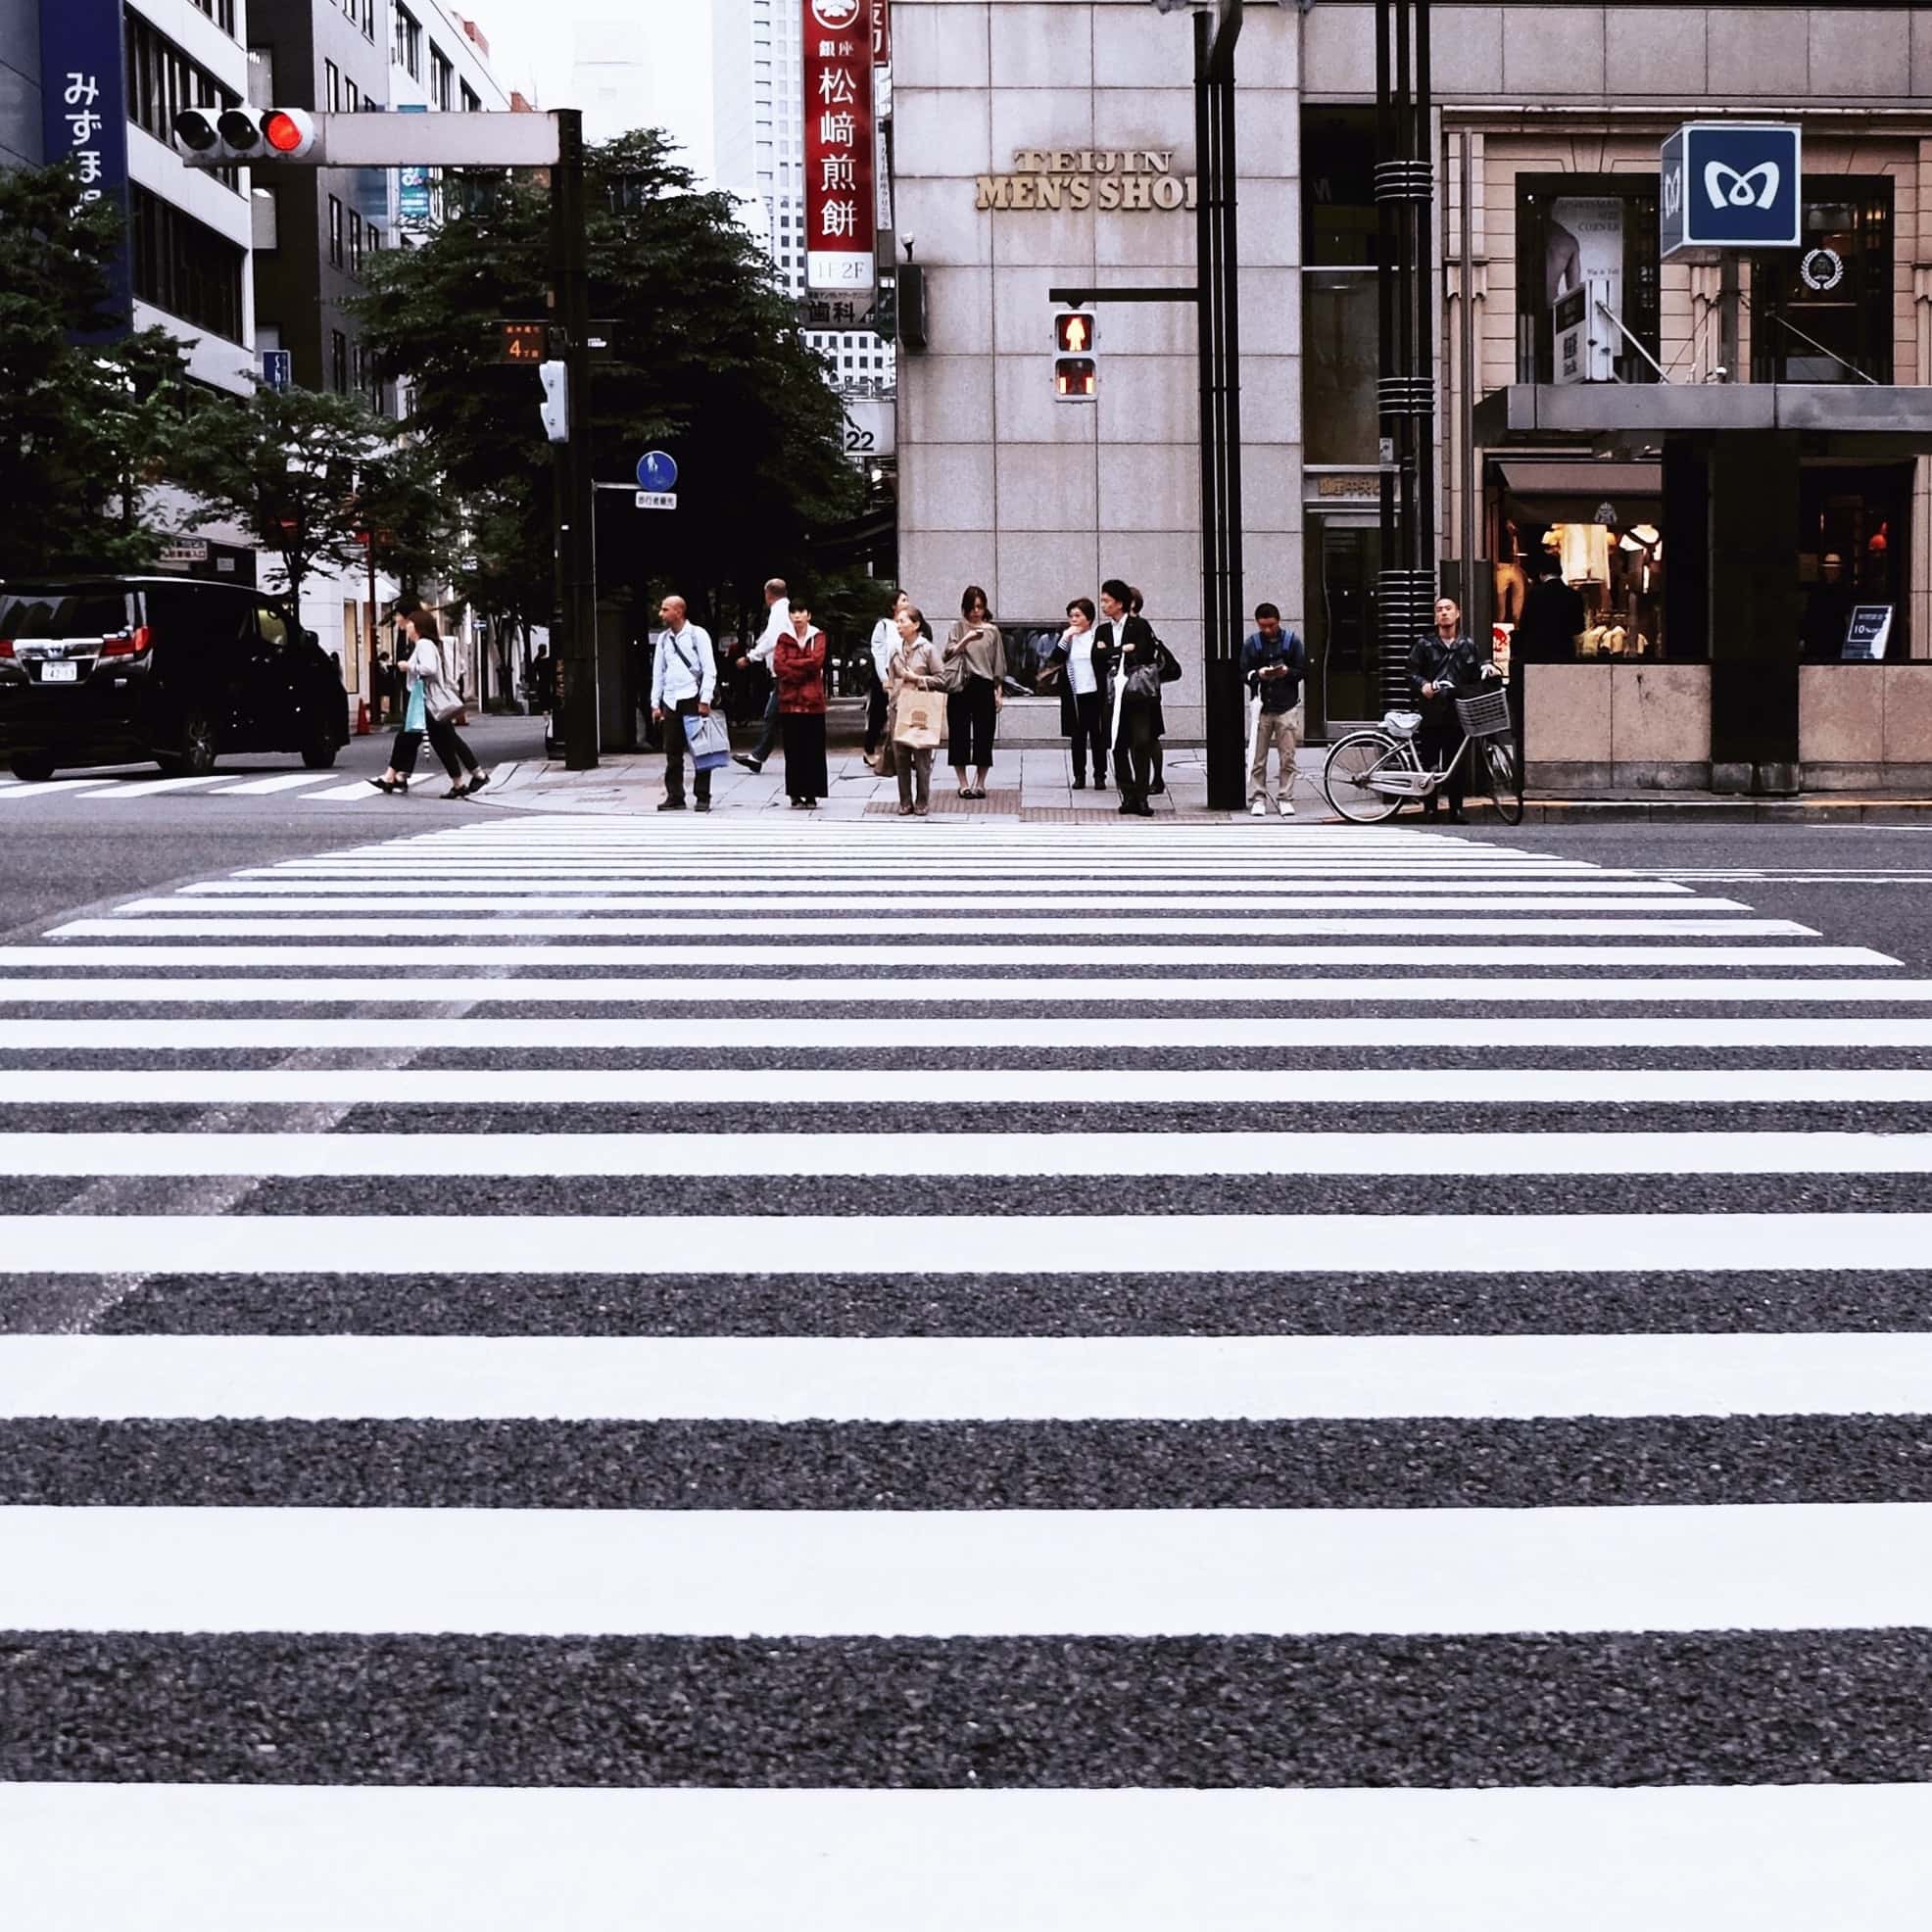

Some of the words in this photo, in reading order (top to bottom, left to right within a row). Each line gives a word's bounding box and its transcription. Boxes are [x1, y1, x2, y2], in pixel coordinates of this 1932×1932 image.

[818, 40, 853, 57] 銀座
[64, 72, 102, 217] みずほ
[1014, 151, 1173, 173] TEIJIN
[976, 176, 1091, 210] MEN'S
[842, 262, 864, 279] 2F
[809, 300, 855, 323] 歯科
[845, 431, 875, 451] 22
